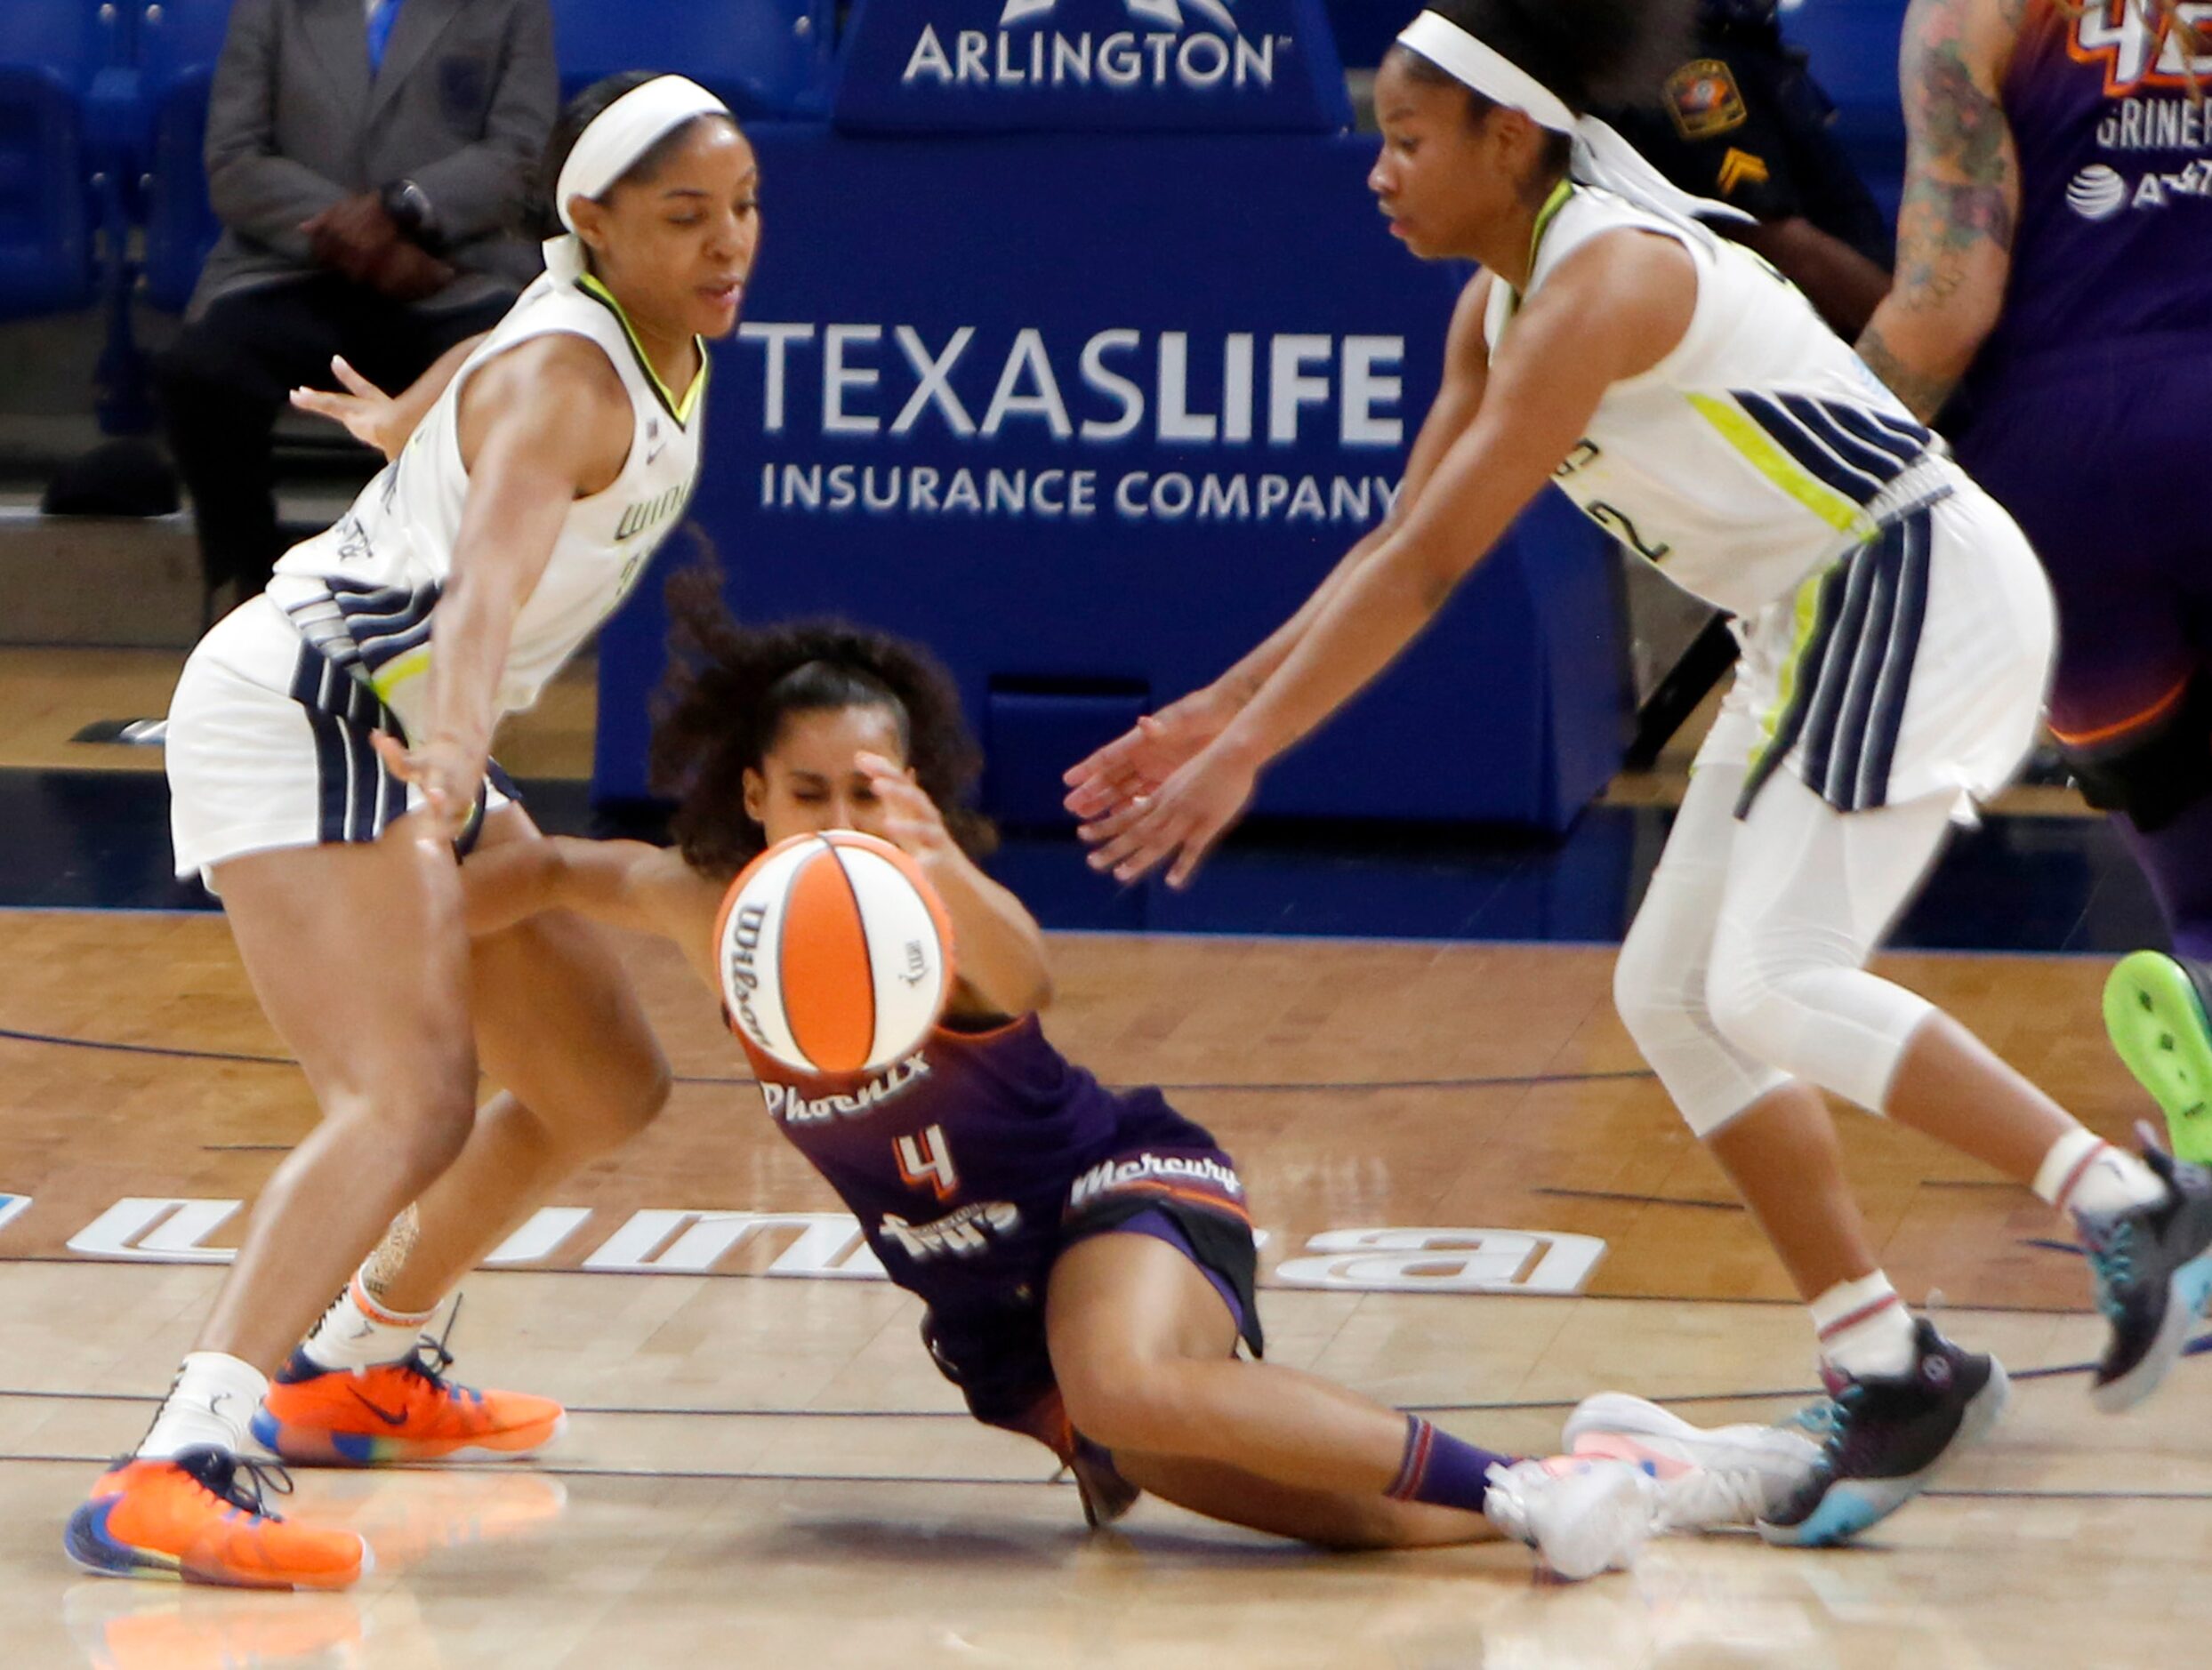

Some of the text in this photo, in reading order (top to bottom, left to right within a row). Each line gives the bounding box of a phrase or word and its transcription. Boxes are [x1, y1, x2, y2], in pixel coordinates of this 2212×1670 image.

[902, 22, 1274, 86] ARLINGTON
[760, 462, 1098, 516] INSURANCE
[733, 902, 773, 1048] Wilson
[760, 1049, 931, 1122] Phoenix
[892, 1123, 960, 1199] 4
[1070, 1152, 1242, 1208] Mercury
